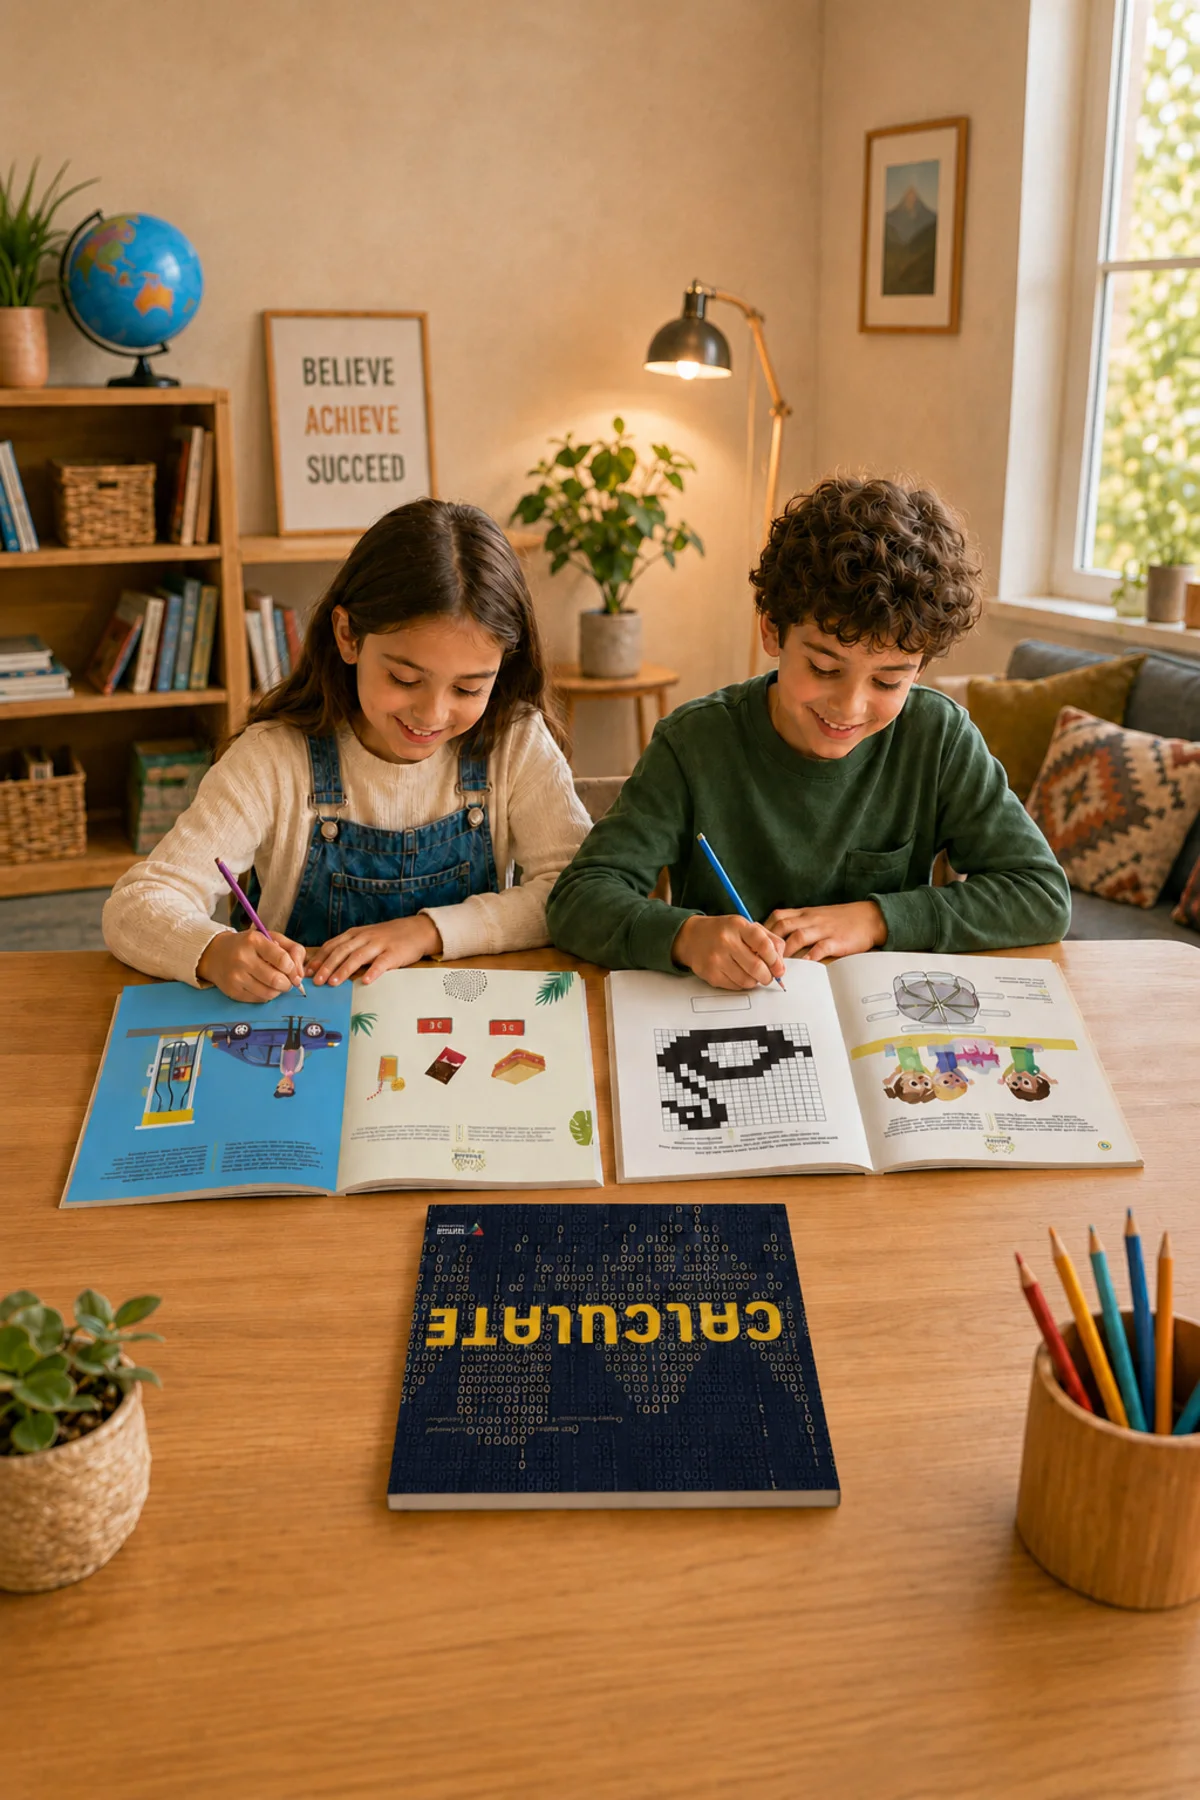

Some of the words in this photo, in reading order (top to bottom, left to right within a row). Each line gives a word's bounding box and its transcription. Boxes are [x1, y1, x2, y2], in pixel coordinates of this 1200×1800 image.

[302, 357, 395, 386] BELIEVE
[305, 405, 400, 436] ACHIEVE
[307, 454, 405, 484] SUCCEED
[426, 1301, 781, 1346] CALCULATE
